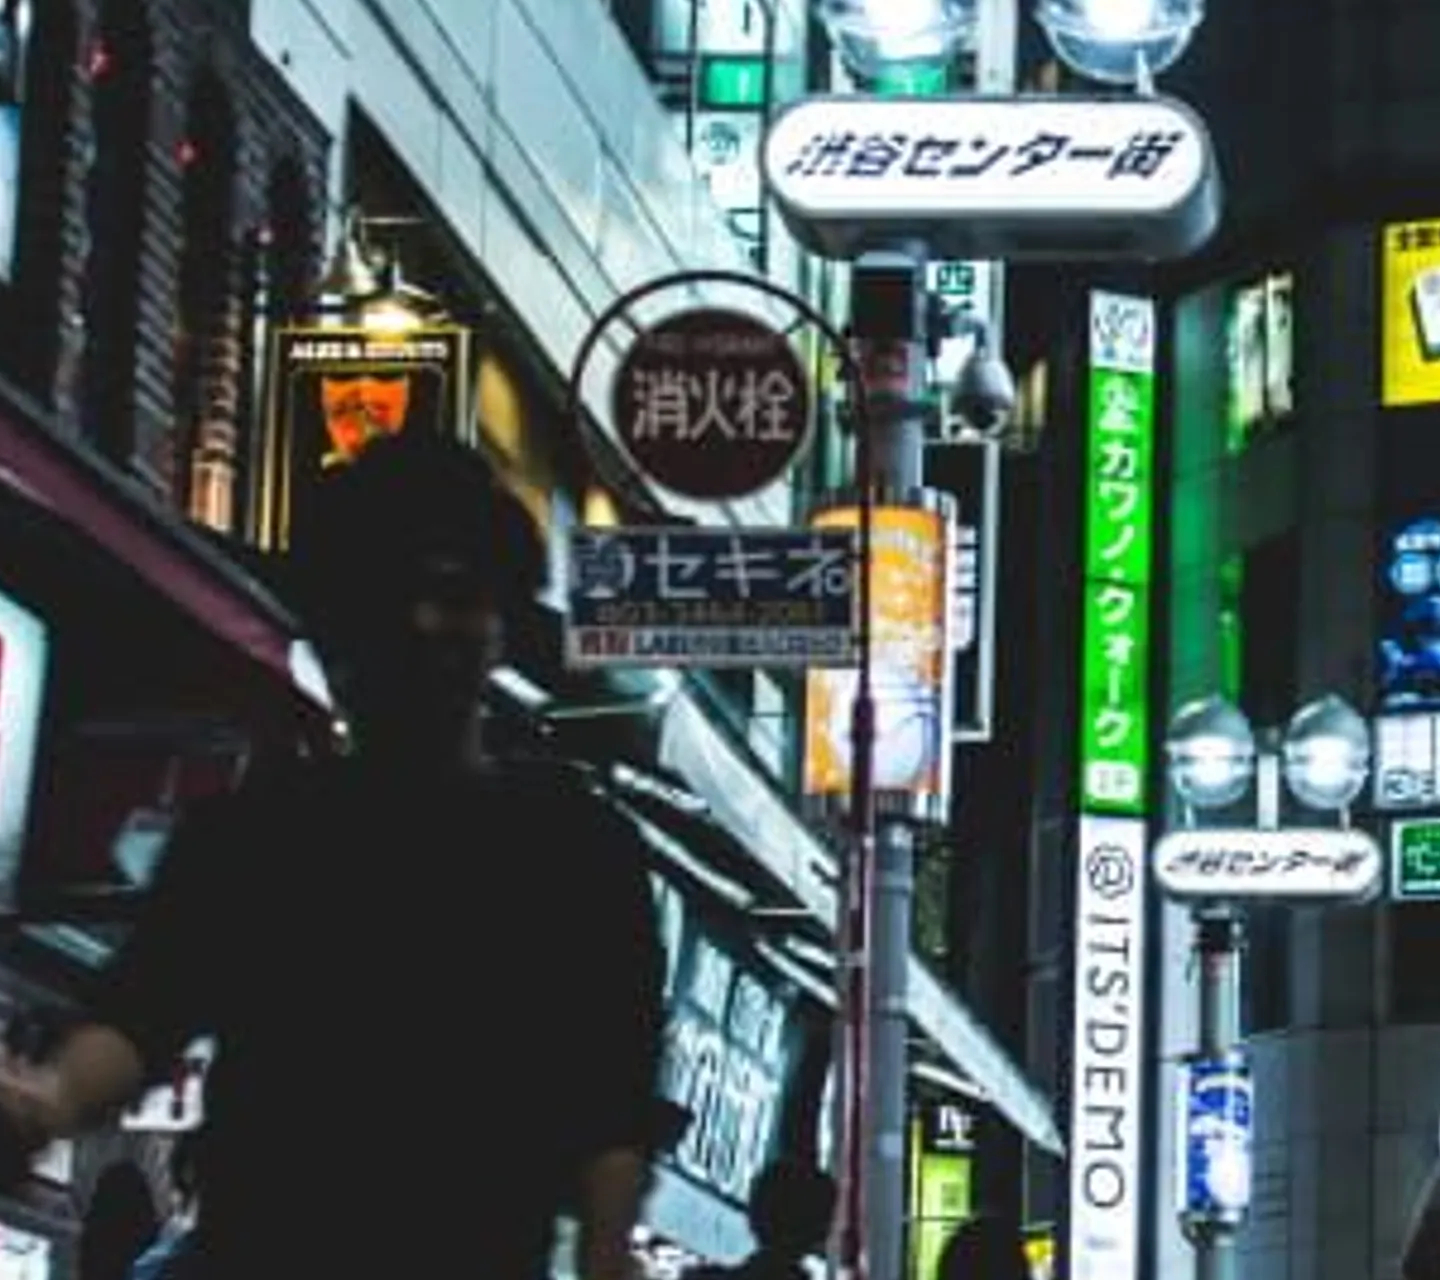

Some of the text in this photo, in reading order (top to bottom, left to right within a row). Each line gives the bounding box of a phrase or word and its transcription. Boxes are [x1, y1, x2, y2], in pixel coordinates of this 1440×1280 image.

[786, 129, 1187, 180] 渋谷センター街
[631, 368, 797, 443] 消火栓
[644, 535, 849, 600] セキネ
